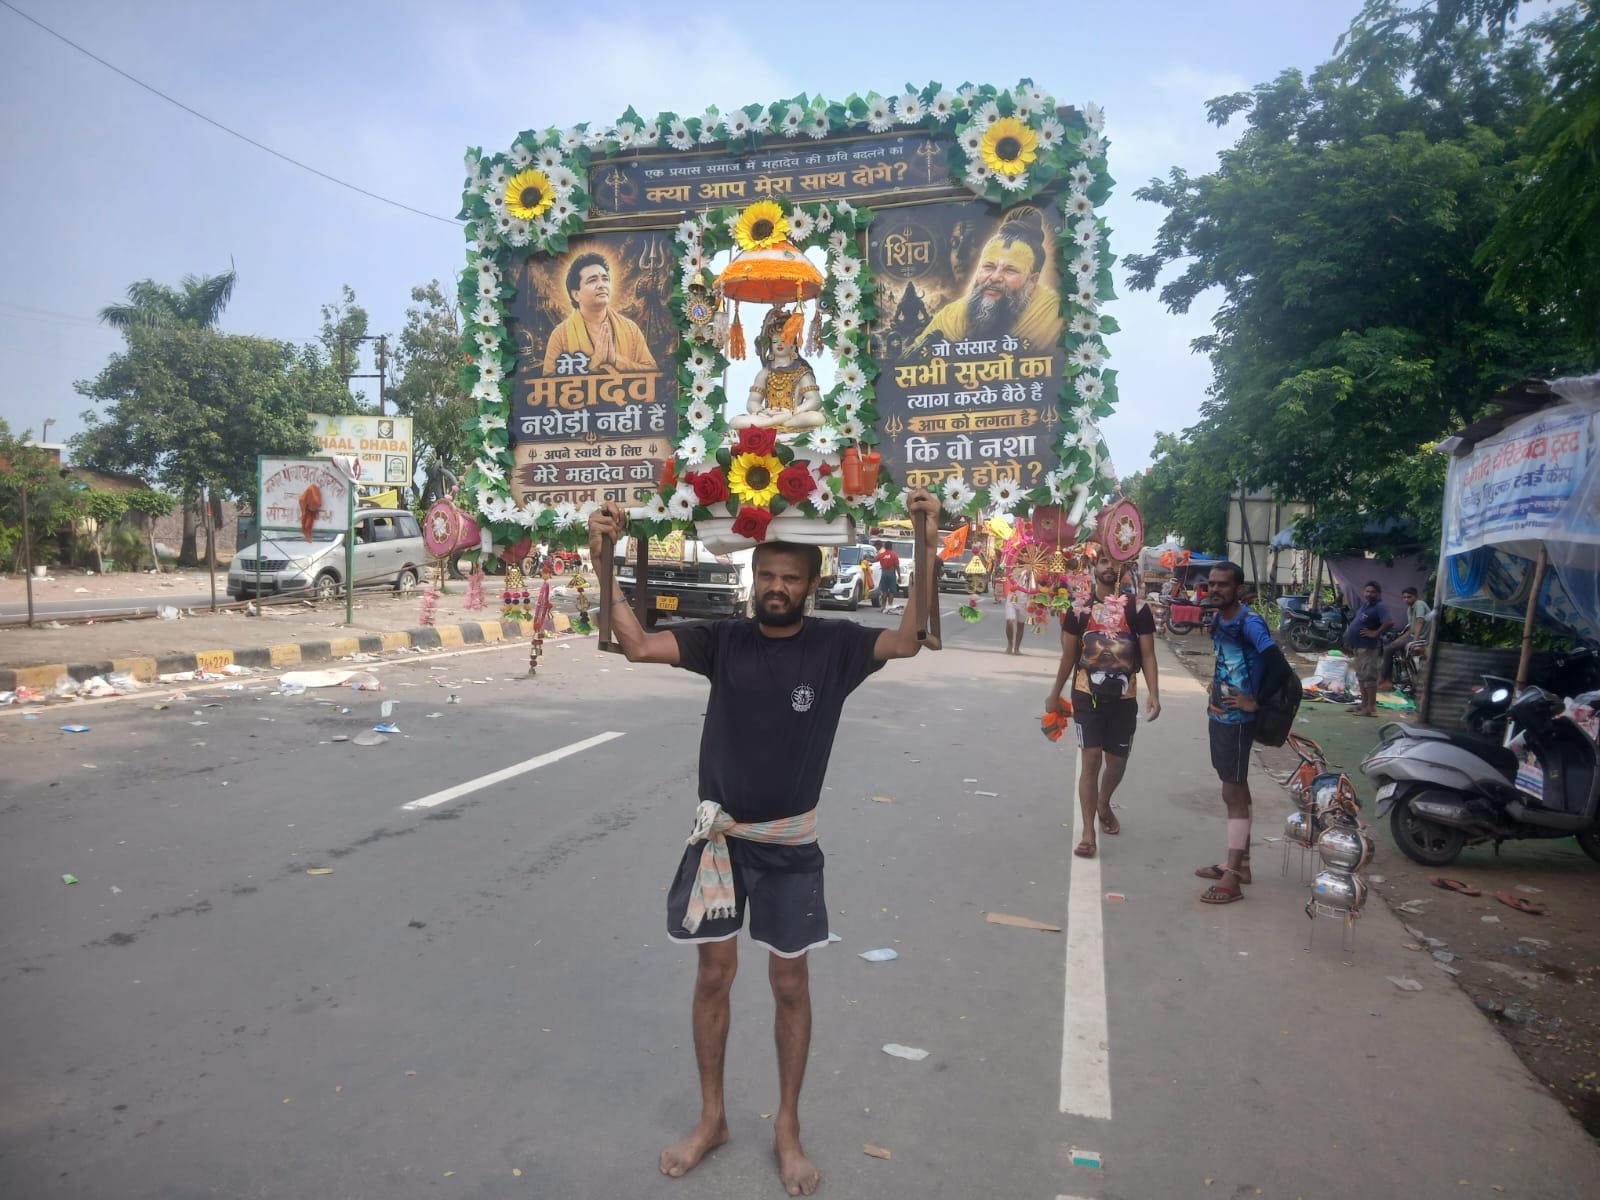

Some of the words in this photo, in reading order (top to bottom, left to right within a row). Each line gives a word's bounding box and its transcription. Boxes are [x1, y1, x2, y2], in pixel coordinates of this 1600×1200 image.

[645, 167, 665, 178] एक
[669, 165, 701, 178] प्रयास
[705, 162, 740, 175] समाज
[746, 159, 756, 171] में
[761, 157, 799, 171] महादेव
[805, 153, 821, 166] की
[826, 152, 848, 164] छवि
[852, 147, 885, 159] बदलने
[889, 146, 903, 156] का
[646, 183, 690, 204] क्या
[697, 179, 746, 199] आप
[753, 174, 792, 195] मेरा
[800, 171, 846, 190] साथ
[852, 161, 908, 185] दोगे?
[885, 234, 931, 267] शिव
[931, 339, 951, 357] जो
[955, 337, 998, 356] संसार
[1002, 334, 1020, 352] के
[556, 352, 591, 375] मेरे
[894, 357, 949, 388] सभी
[953, 353, 1016, 390] सुखों
[1019, 355, 1053, 380] का
[524, 363, 664, 411] महादेव
[907, 392, 949, 409] त्याग
[954, 386, 998, 406] करके
[1002, 384, 1027, 403] बैठे
[1030, 381, 1044, 401] हैं
[594, 403, 643, 433] नहीं
[648, 402, 667, 431] हैं
[918, 416, 947, 432] आप
[951, 413, 970, 430] को
[974, 414, 1016, 429] लगता
[1020, 411, 1034, 425] है
[317, 437, 355, 449] HAAL
[359, 438, 409, 453] DHABA
[543, 446, 571, 460] अपने
[574, 446, 602, 459] स्वार्थ
[605, 444, 617, 457] के
[621, 444, 643, 457] लिए
[904, 435, 940, 465] कि
[946, 435, 975, 463] वो
[979, 434, 1038, 458] नशा
[533, 463, 560, 484] मेरे
[565, 462, 625, 483] महादेव
[630, 460, 654, 480] को
[521, 488, 597, 505] बदनाम
[603, 487, 628, 503] ना
